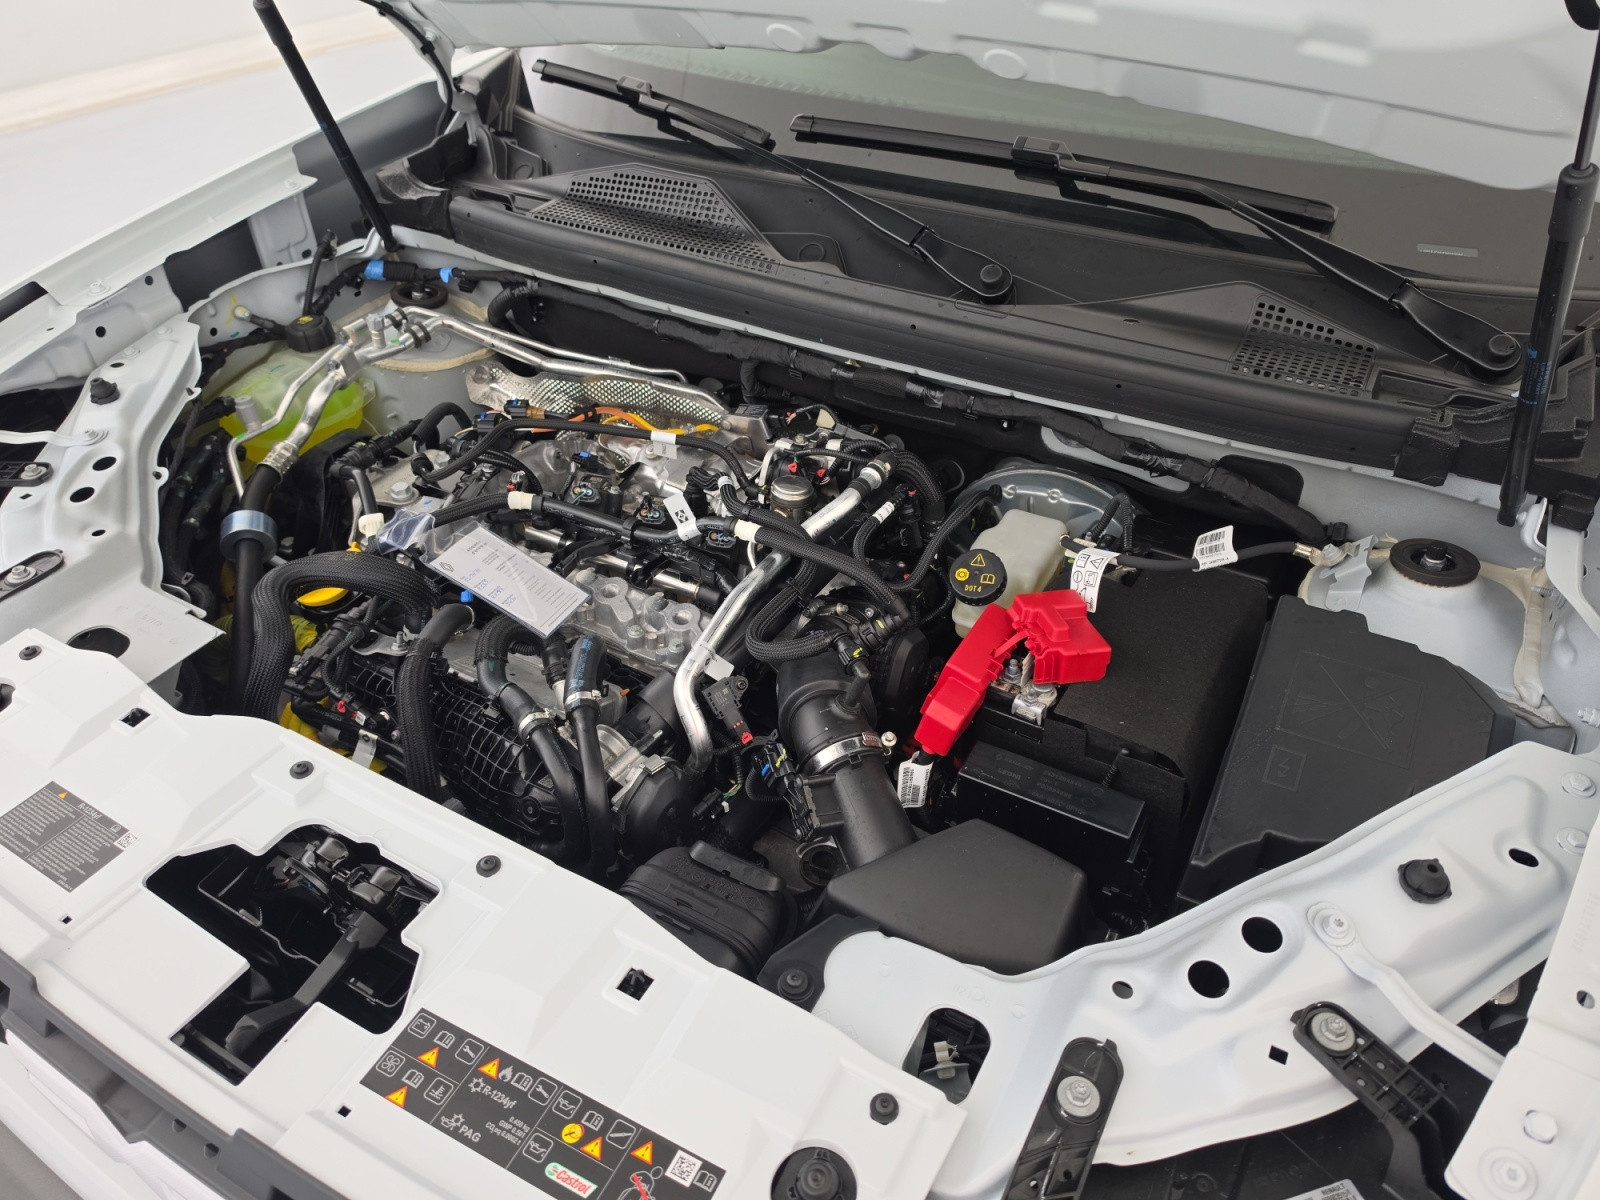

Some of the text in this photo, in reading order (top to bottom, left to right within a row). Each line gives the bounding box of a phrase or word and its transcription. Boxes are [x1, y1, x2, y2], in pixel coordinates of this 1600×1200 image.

[481, 1085, 518, 1109] R-1234yf
[458, 1124, 482, 1143] PAG
[556, 1170, 592, 1195] Castrol
